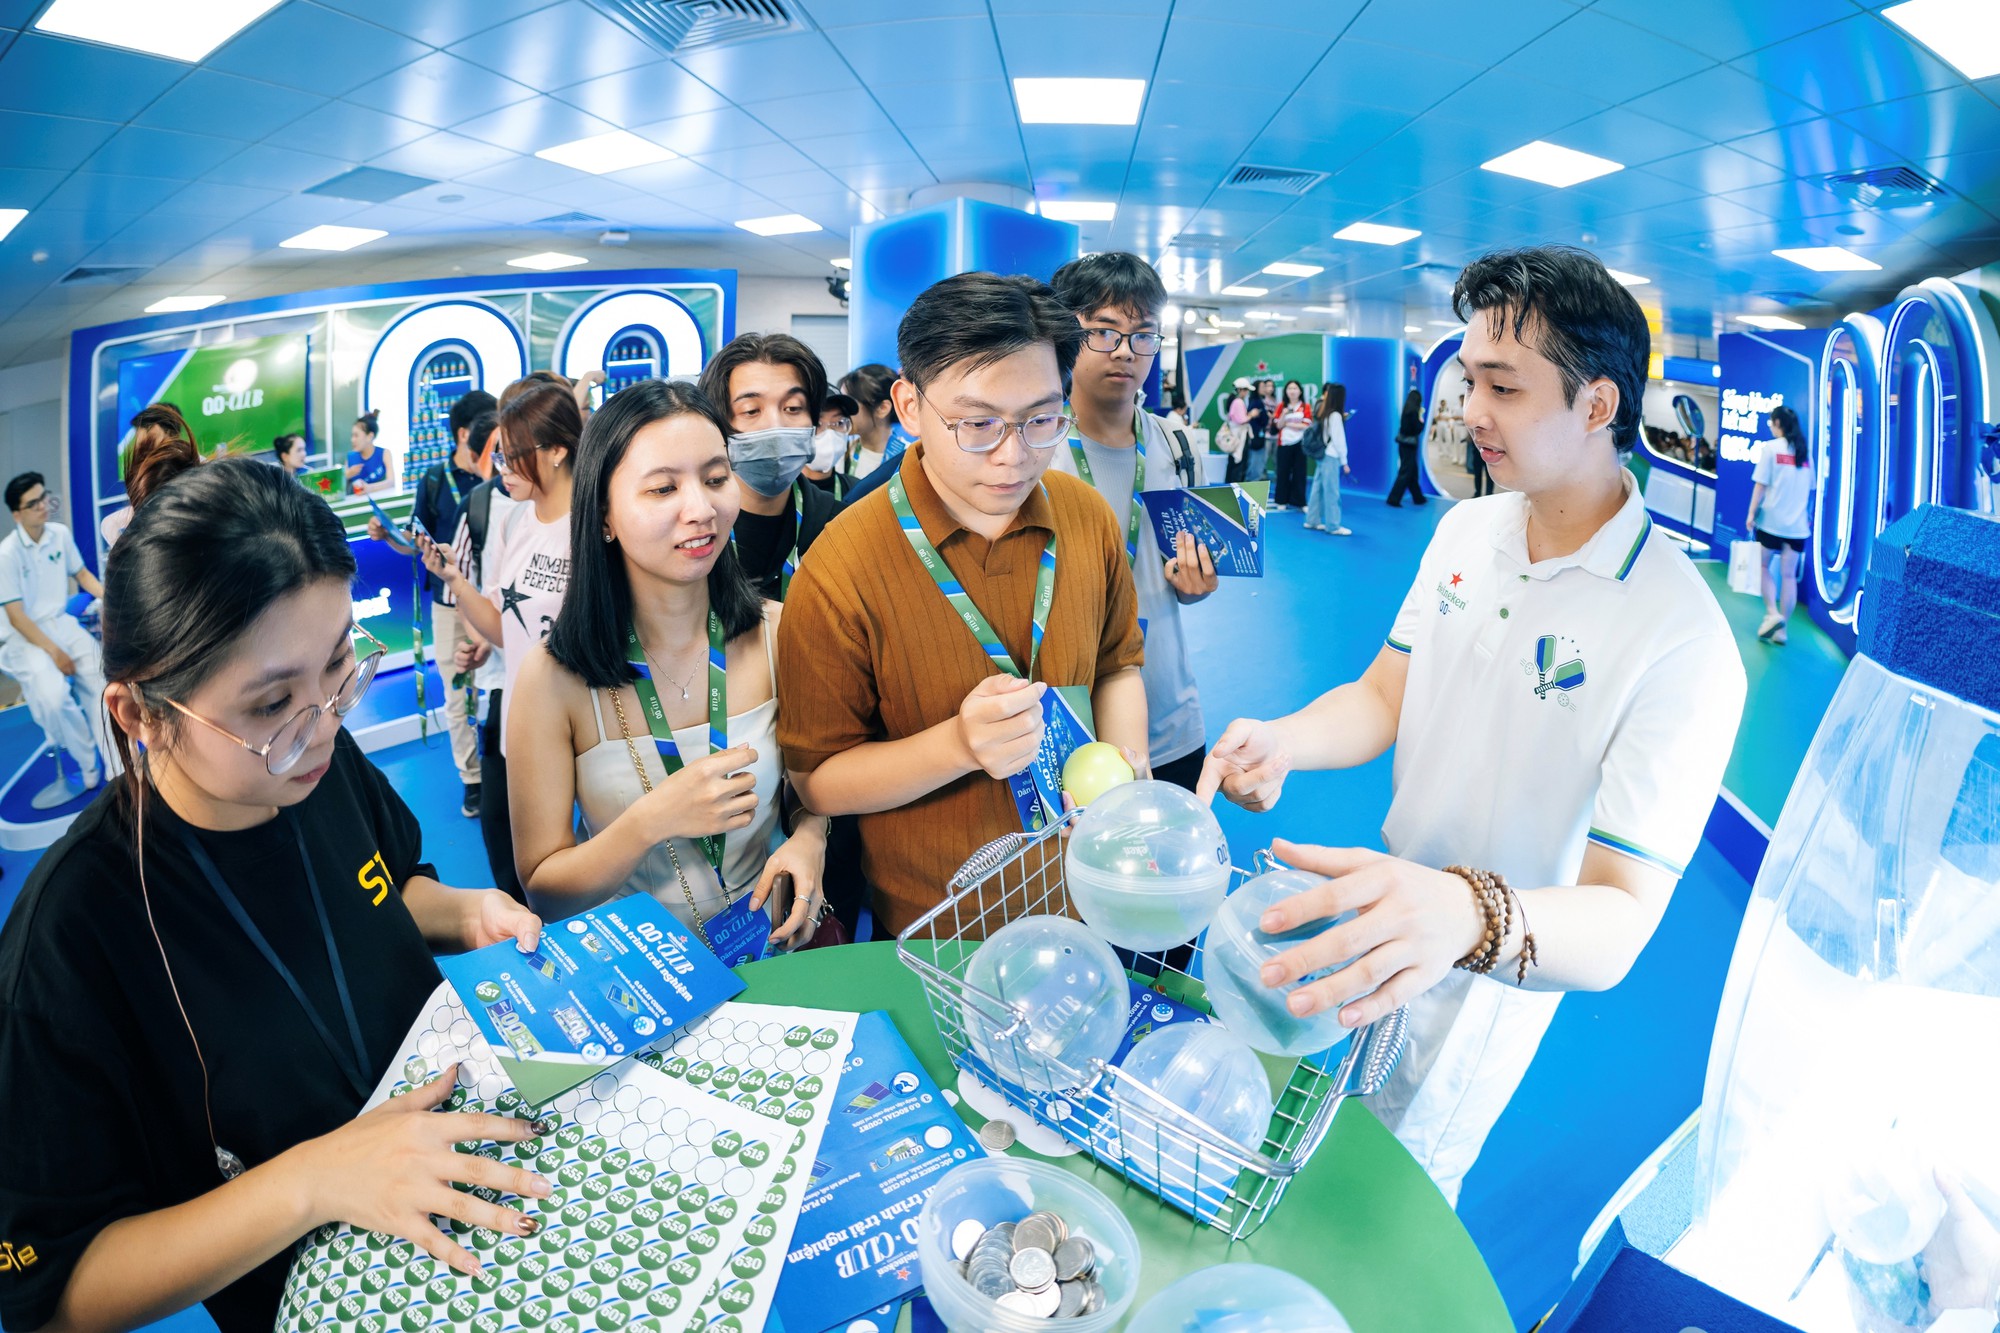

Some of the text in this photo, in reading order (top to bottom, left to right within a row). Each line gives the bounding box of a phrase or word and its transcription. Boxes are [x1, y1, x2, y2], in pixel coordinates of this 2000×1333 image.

[522, 569, 568, 593] PERFEC
[607, 912, 629, 933] Hành
[625, 927, 648, 954] trình
[645, 948, 663, 970] trải
[659, 965, 694, 1003] nghiệm
[656, 941, 695, 976] CLUB
[788, 1031, 834, 1044] 517 518
[664, 1061, 684, 1074] 541
[688, 1067, 709, 1079] 542
[714, 1071, 736, 1083] 543
[740, 1075, 763, 1087] 544
[768, 1078, 791, 1092] 545
[795, 1081, 819, 1093] 546
[759, 1102, 782, 1116] 559
[788, 1106, 811, 1120] 560
[859, 1118, 883, 1133] COURT
[882, 1107, 909, 1122] SOCIAL
[406, 1062, 425, 1080] 547
[448, 1093, 463, 1107] 49
[518, 1139, 539, 1155] 553
[540, 1152, 561, 1168] 554
[562, 1165, 583, 1182] 555
[585, 1179, 608, 1196] 556
[609, 1192, 633, 1208] 557
[635, 1205, 659, 1222] 558
[663, 1217, 687, 1235] 559
[690, 1230, 716, 1248] 560
[716, 1138, 765, 1162] 517 518
[559, 1128, 580, 1144] 540
[582, 1141, 602, 1158] 541
[604, 1154, 626, 1170] 542
[628, 1166, 651, 1183] 543
[655, 1178, 678, 1196] 544
[681, 1189, 704, 1207] 545
[708, 1202, 734, 1219] 546
[918, 1163, 940, 1177] CHECK
[882, 1183, 901, 1195] CLUB
[801, 1199, 821, 1214] PLAY
[547, 1191, 564, 1208] 69
[564, 1204, 586, 1221] 570
[590, 1218, 612, 1235] 571
[615, 1232, 639, 1250] 572
[642, 1246, 667, 1264] 573
[670, 1260, 696, 1279] 574
[747, 1223, 772, 1237] 616
[787, 1193, 923, 1264] trình trải nghiệm
[544, 1231, 566, 1248] 584
[568, 1245, 592, 1263] 585
[594, 1260, 619, 1278] 586
[623, 1275, 648, 1293] 587
[651, 1291, 677, 1310] 588
[735, 1255, 762, 1270] 630
[835, 1232, 896, 1279] CLUB
[332, 1238, 350, 1256] 634
[348, 1254, 367, 1272] 635
[366, 1272, 386, 1290] 636
[386, 1289, 408, 1308] 637
[406, 1307, 428, 1328] 638
[372, 1230, 499, 1333] 621 622 623 624 625 626
[476, 1227, 626, 1325] 596 597 598 599 600 601
[311, 1265, 327, 1282] 648
[324, 1280, 343, 1299] 649
[341, 1298, 361, 1317] 650
[361, 1316, 381, 1333] 651
[500, 1287, 521, 1306] 612
[523, 1301, 548, 1322] 613
[722, 1290, 750, 1305] 644
[302, 1308, 320, 1326] 663
